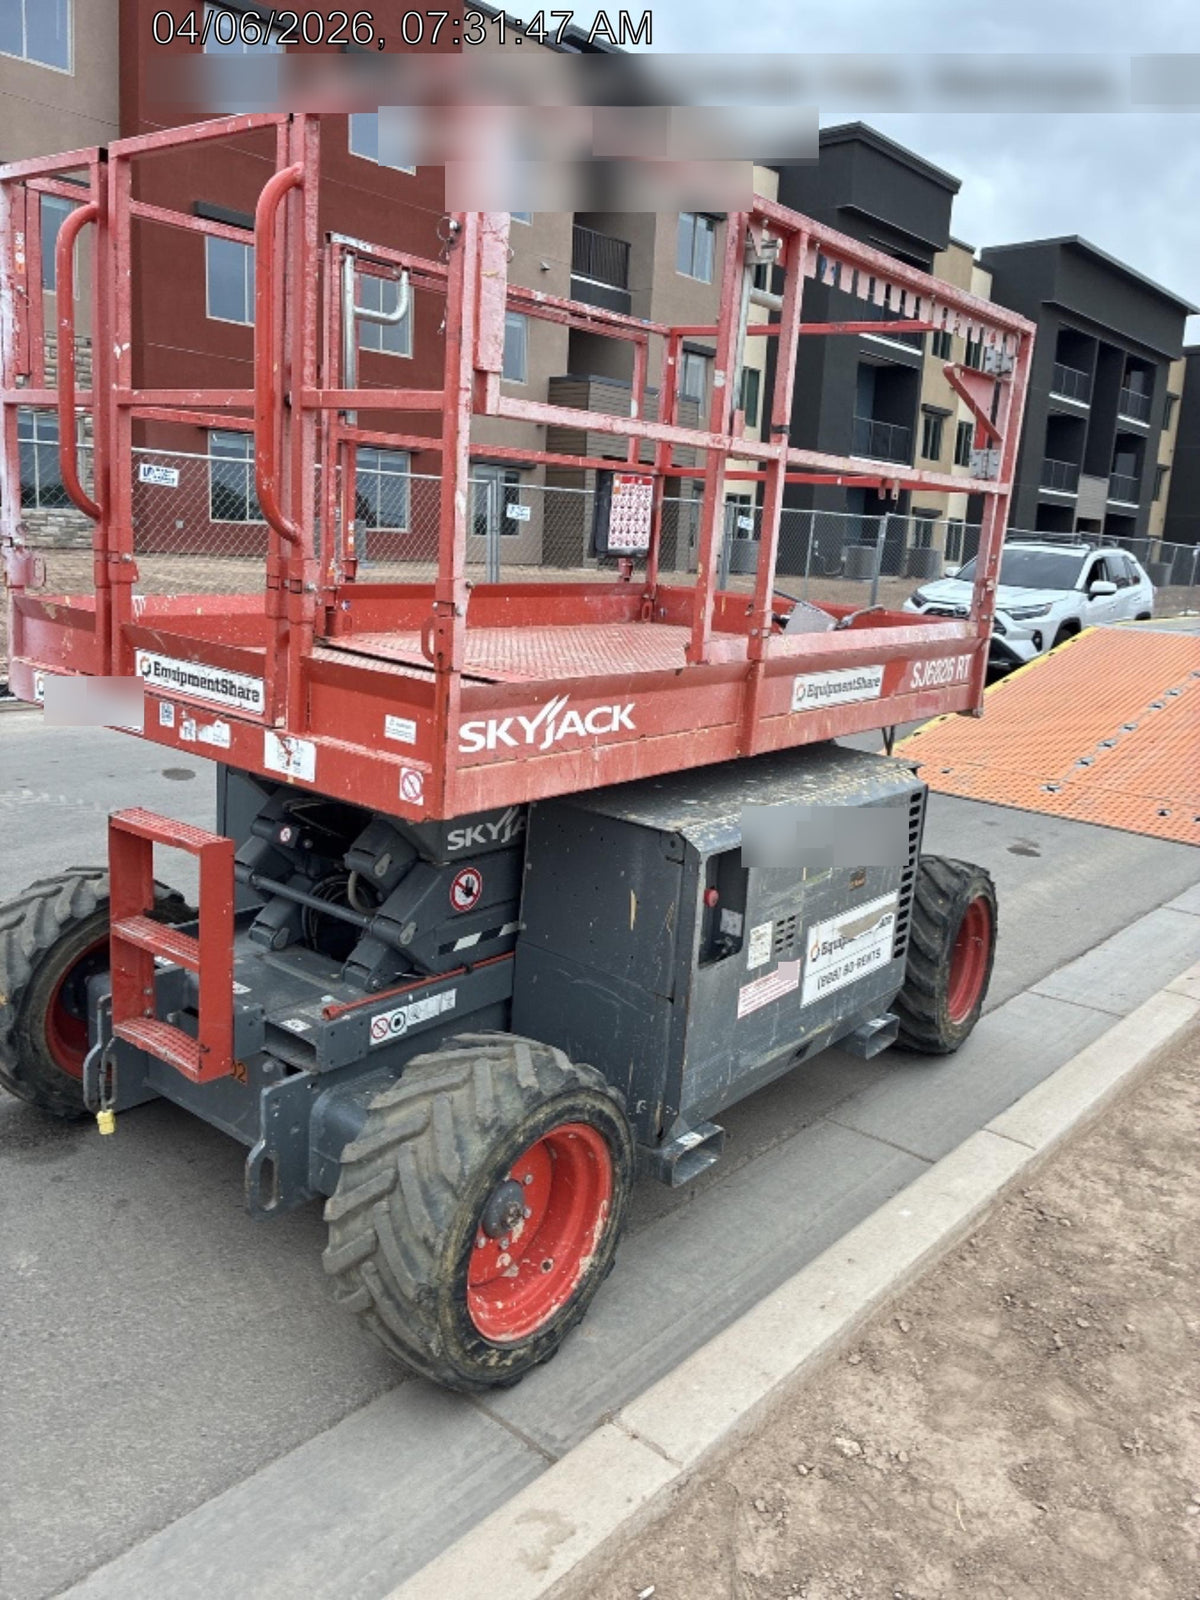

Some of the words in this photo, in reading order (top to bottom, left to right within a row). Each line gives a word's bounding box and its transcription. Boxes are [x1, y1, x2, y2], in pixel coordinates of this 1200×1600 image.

[153, 661, 260, 703] EquipmentShare
[806, 676, 881, 699] EquipmentShare
[910, 655, 956, 689] SJ6826
[955, 653, 974, 680] RT
[458, 693, 637, 753] SKYJACK
